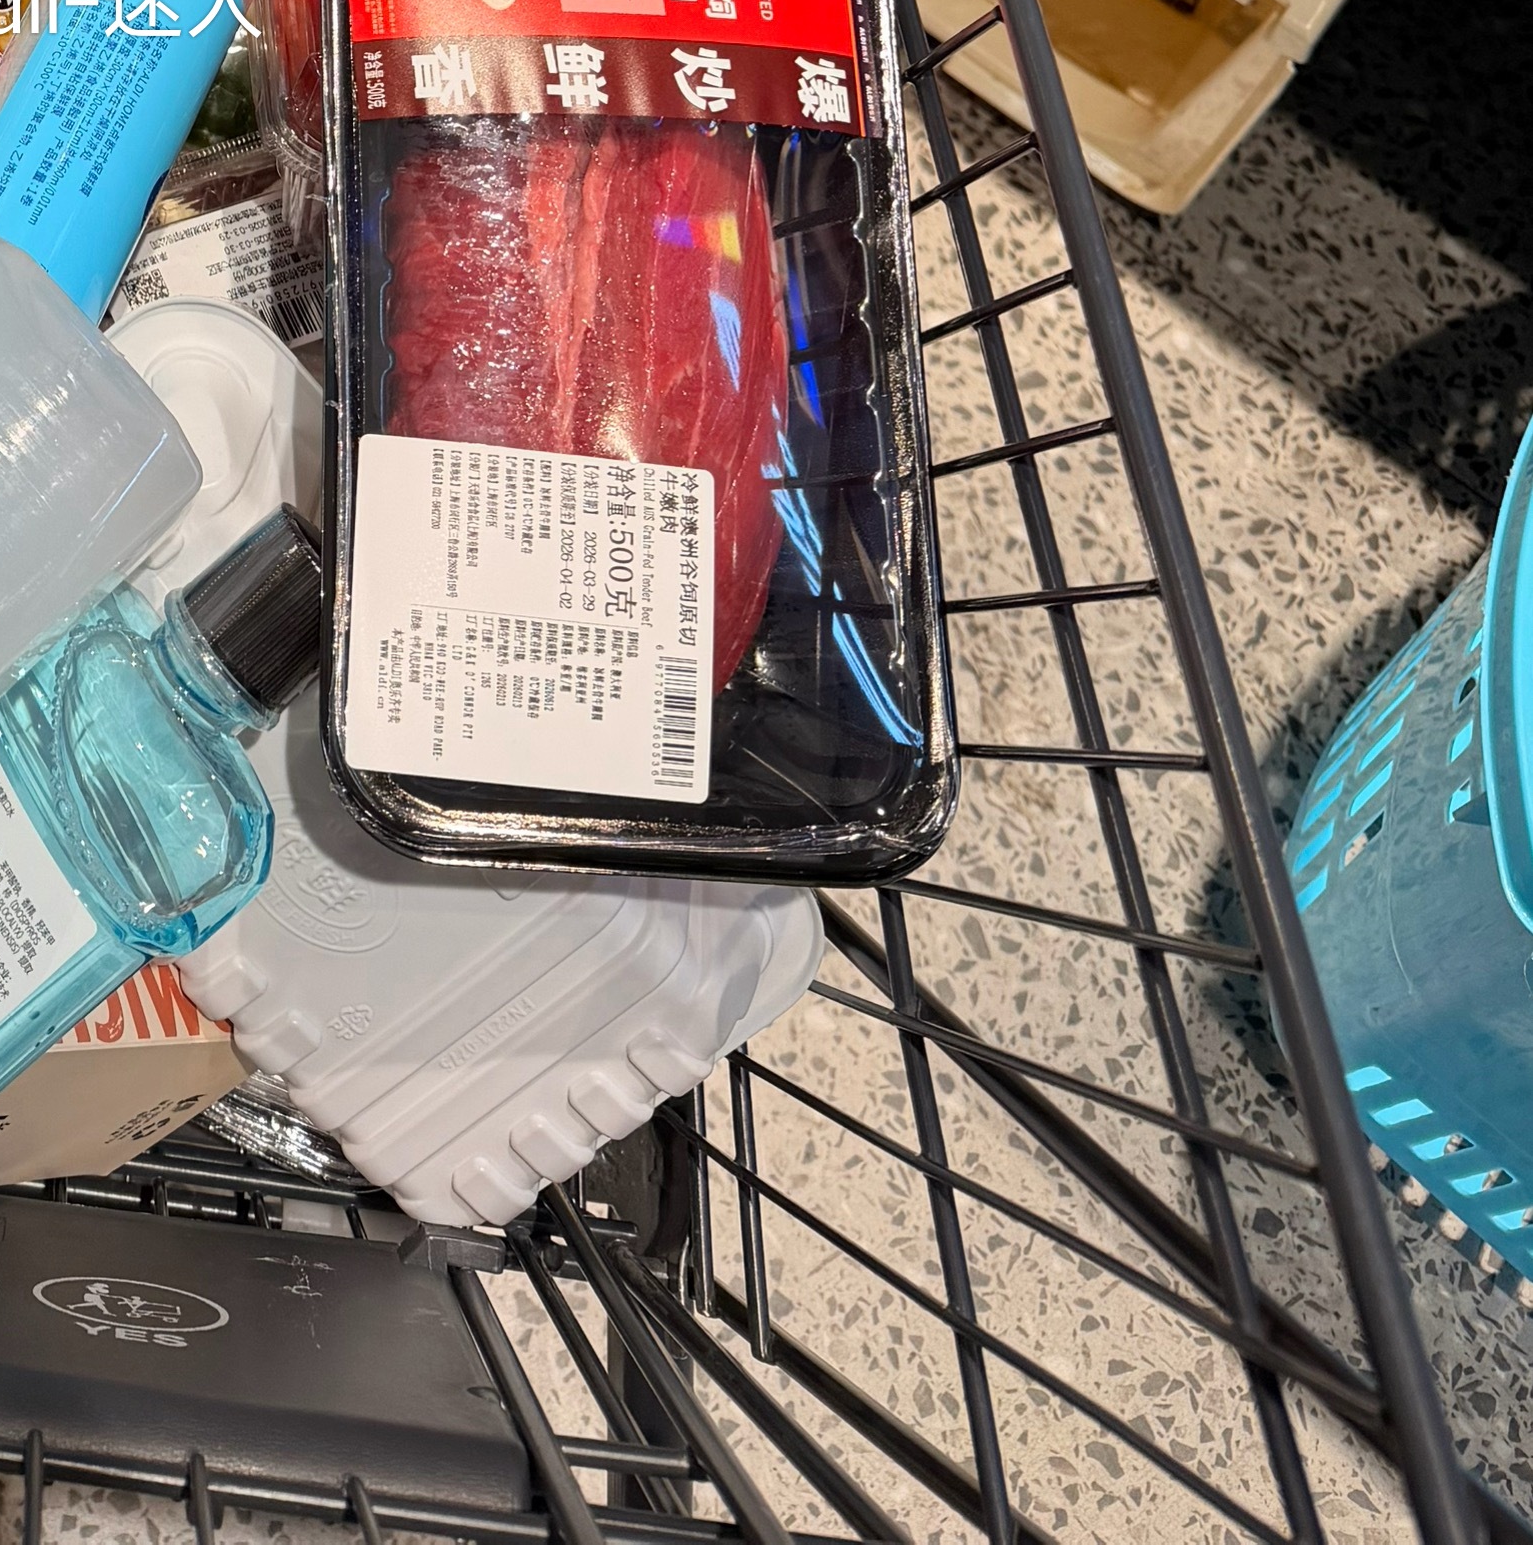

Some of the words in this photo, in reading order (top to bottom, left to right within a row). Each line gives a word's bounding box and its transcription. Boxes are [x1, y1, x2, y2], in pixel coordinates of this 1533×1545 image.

[363, 49, 387, 110] 净含量:500克
[410, 41, 852, 125] 爆炒鲜香
[643, 467, 655, 502] Chilled
[643, 506, 654, 521] AUS
[659, 469, 679, 534] 牛嫩肉
[558, 529, 574, 610] 2026-04-02
[582, 530, 597, 612] 2026-03-29
[604, 465, 637, 620] 净含量:500克
[679, 472, 700, 647] 冷鲜澳洲谷饲原切
[376, 639, 389, 710] www.aldi.cn
[73, 1322, 189, 1348] YES
